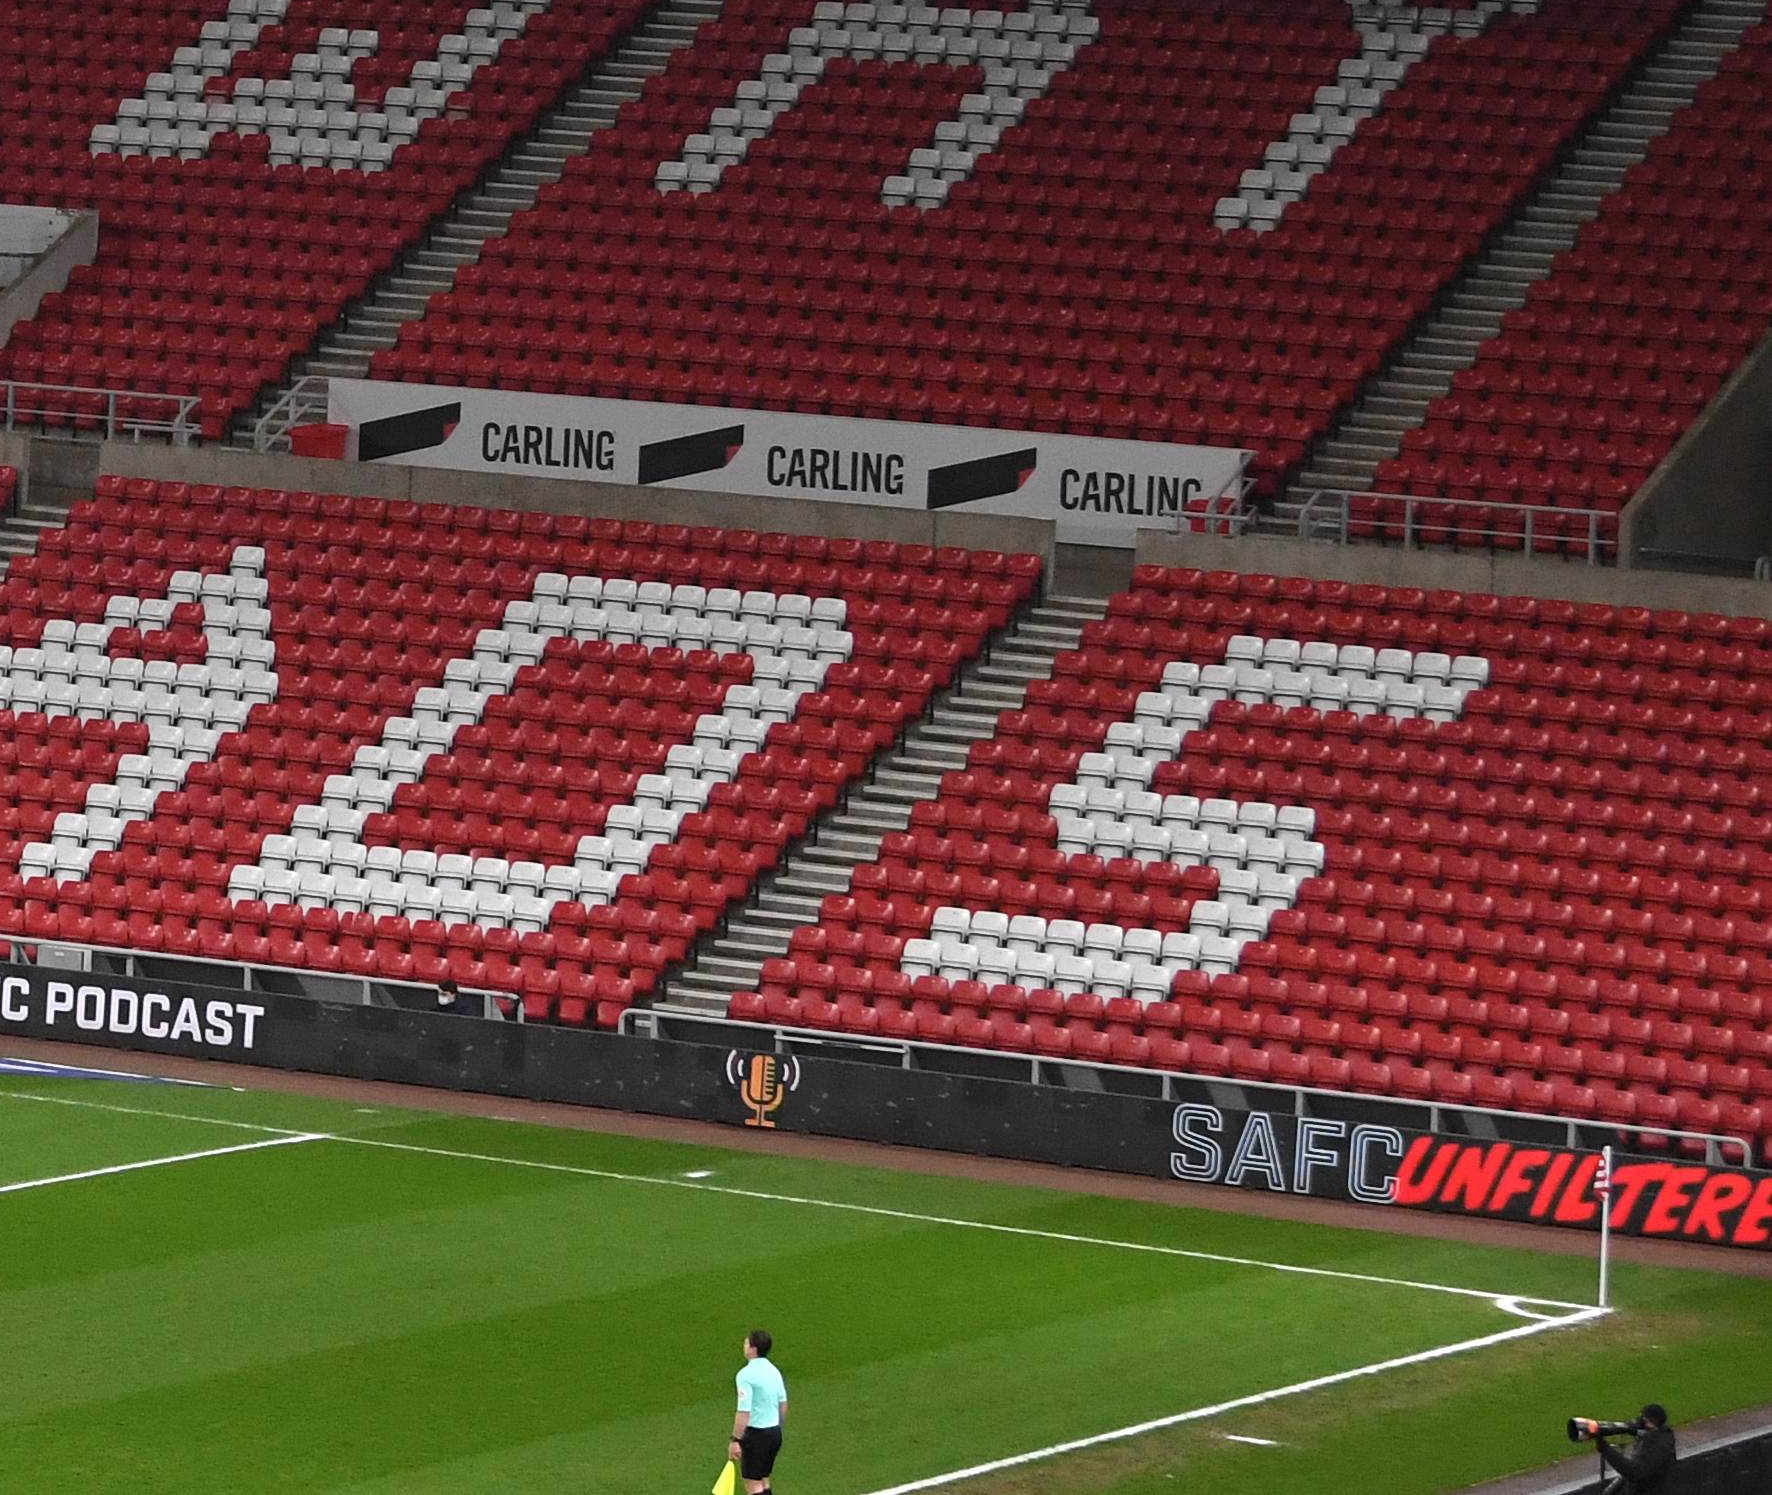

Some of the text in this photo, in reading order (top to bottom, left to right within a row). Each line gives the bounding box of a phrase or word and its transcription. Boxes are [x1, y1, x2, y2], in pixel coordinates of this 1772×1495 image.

[482, 421, 615, 470] CARLING
[767, 445, 905, 495] CARLING
[45, 980, 265, 1048] PODCAST
[1169, 1103, 1403, 1206] SAFC
